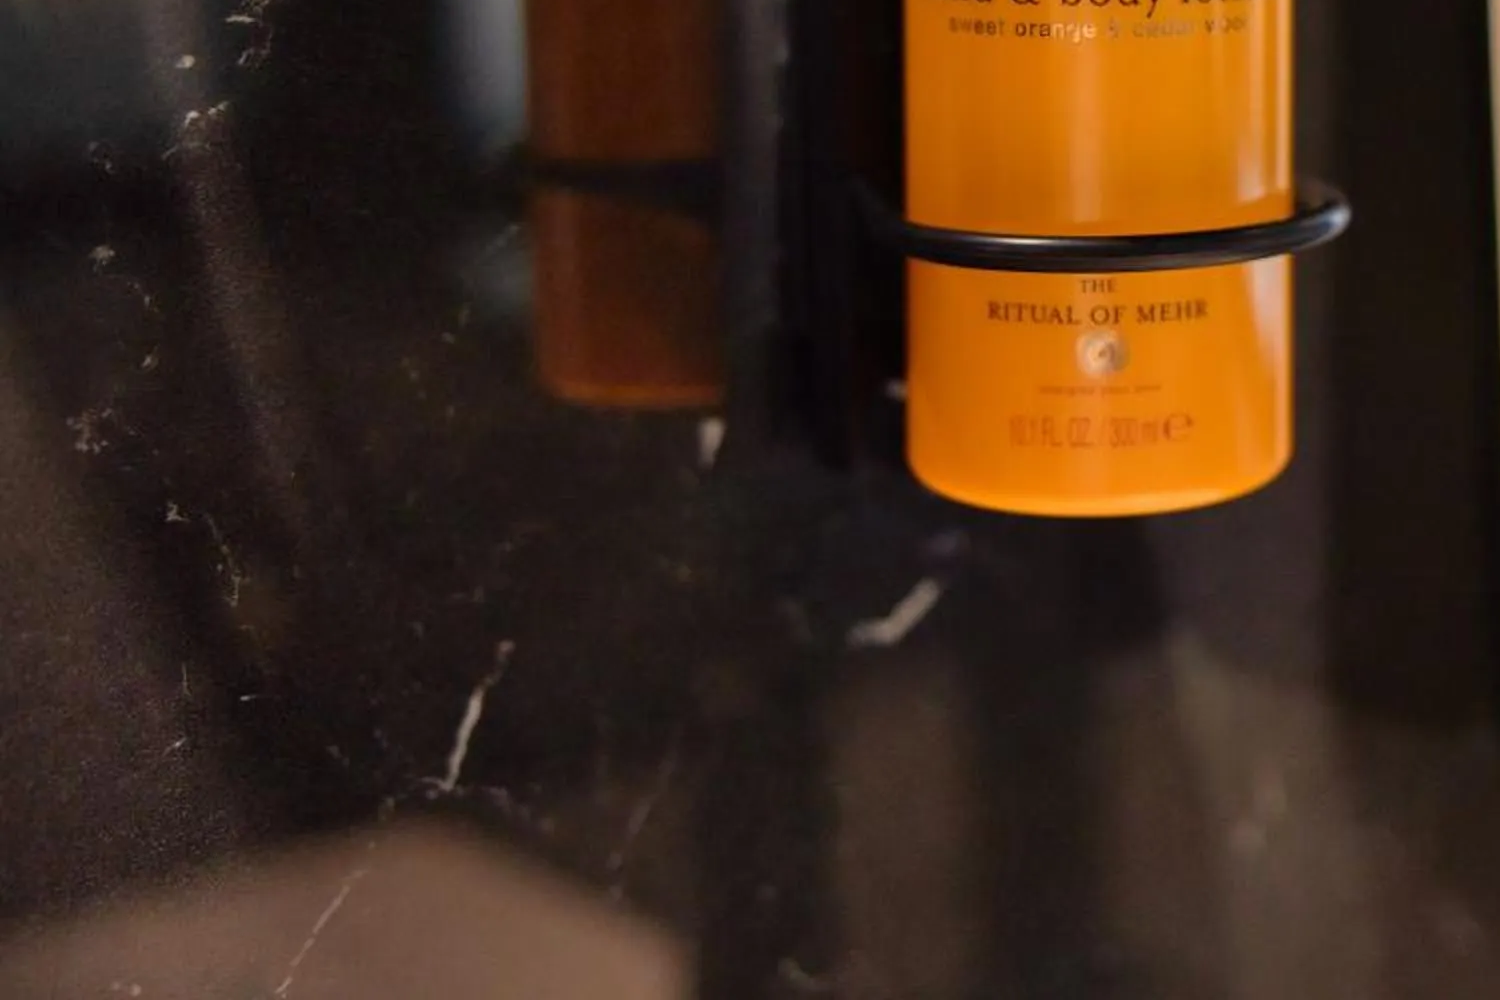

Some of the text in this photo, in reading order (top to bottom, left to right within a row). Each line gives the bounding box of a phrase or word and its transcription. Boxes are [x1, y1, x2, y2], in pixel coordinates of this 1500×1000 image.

[1015, 22, 1098, 44] orange
[1080, 279, 1117, 294] THE
[987, 299, 1209, 326] RITUAL OF MEHR
